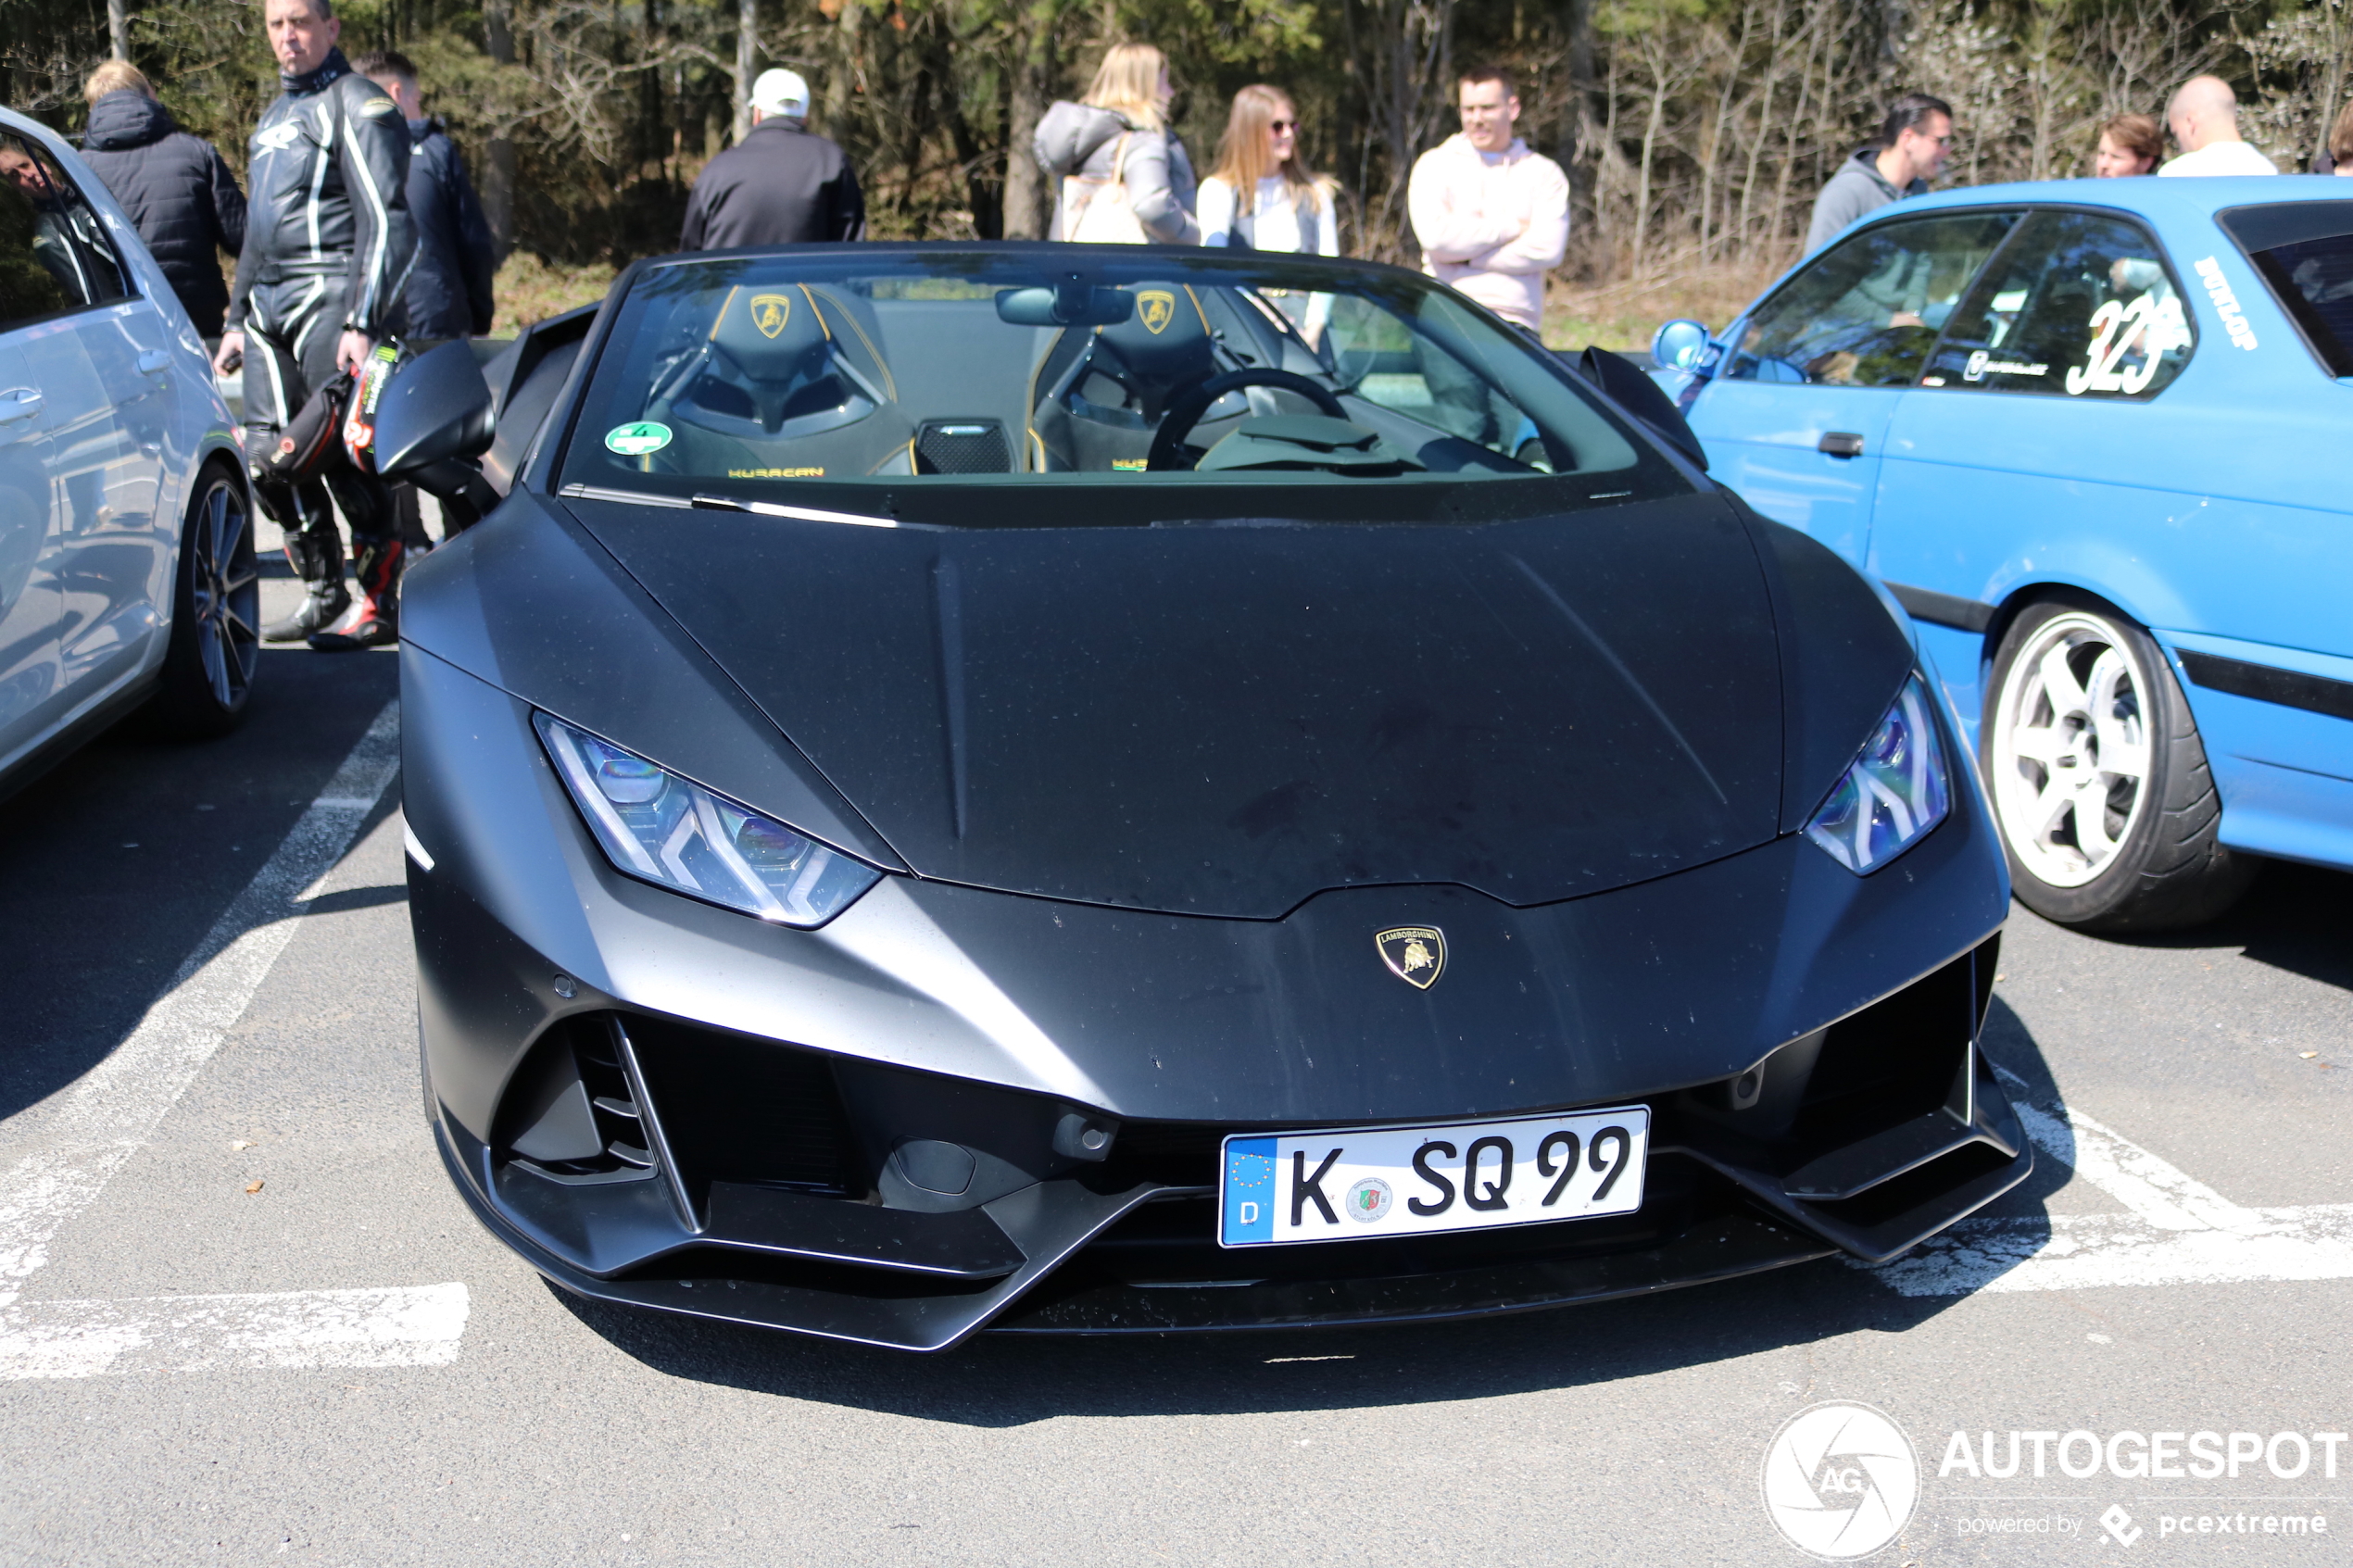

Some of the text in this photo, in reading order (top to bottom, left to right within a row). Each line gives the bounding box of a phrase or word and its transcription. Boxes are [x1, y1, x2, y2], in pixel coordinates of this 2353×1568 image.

[2194, 255, 2259, 351] DUNLOP
[631, 424, 648, 437] 4
[1380, 931, 1436, 944] LAMBORGHINI
[1239, 1125, 1631, 1226] D K SQ 99
